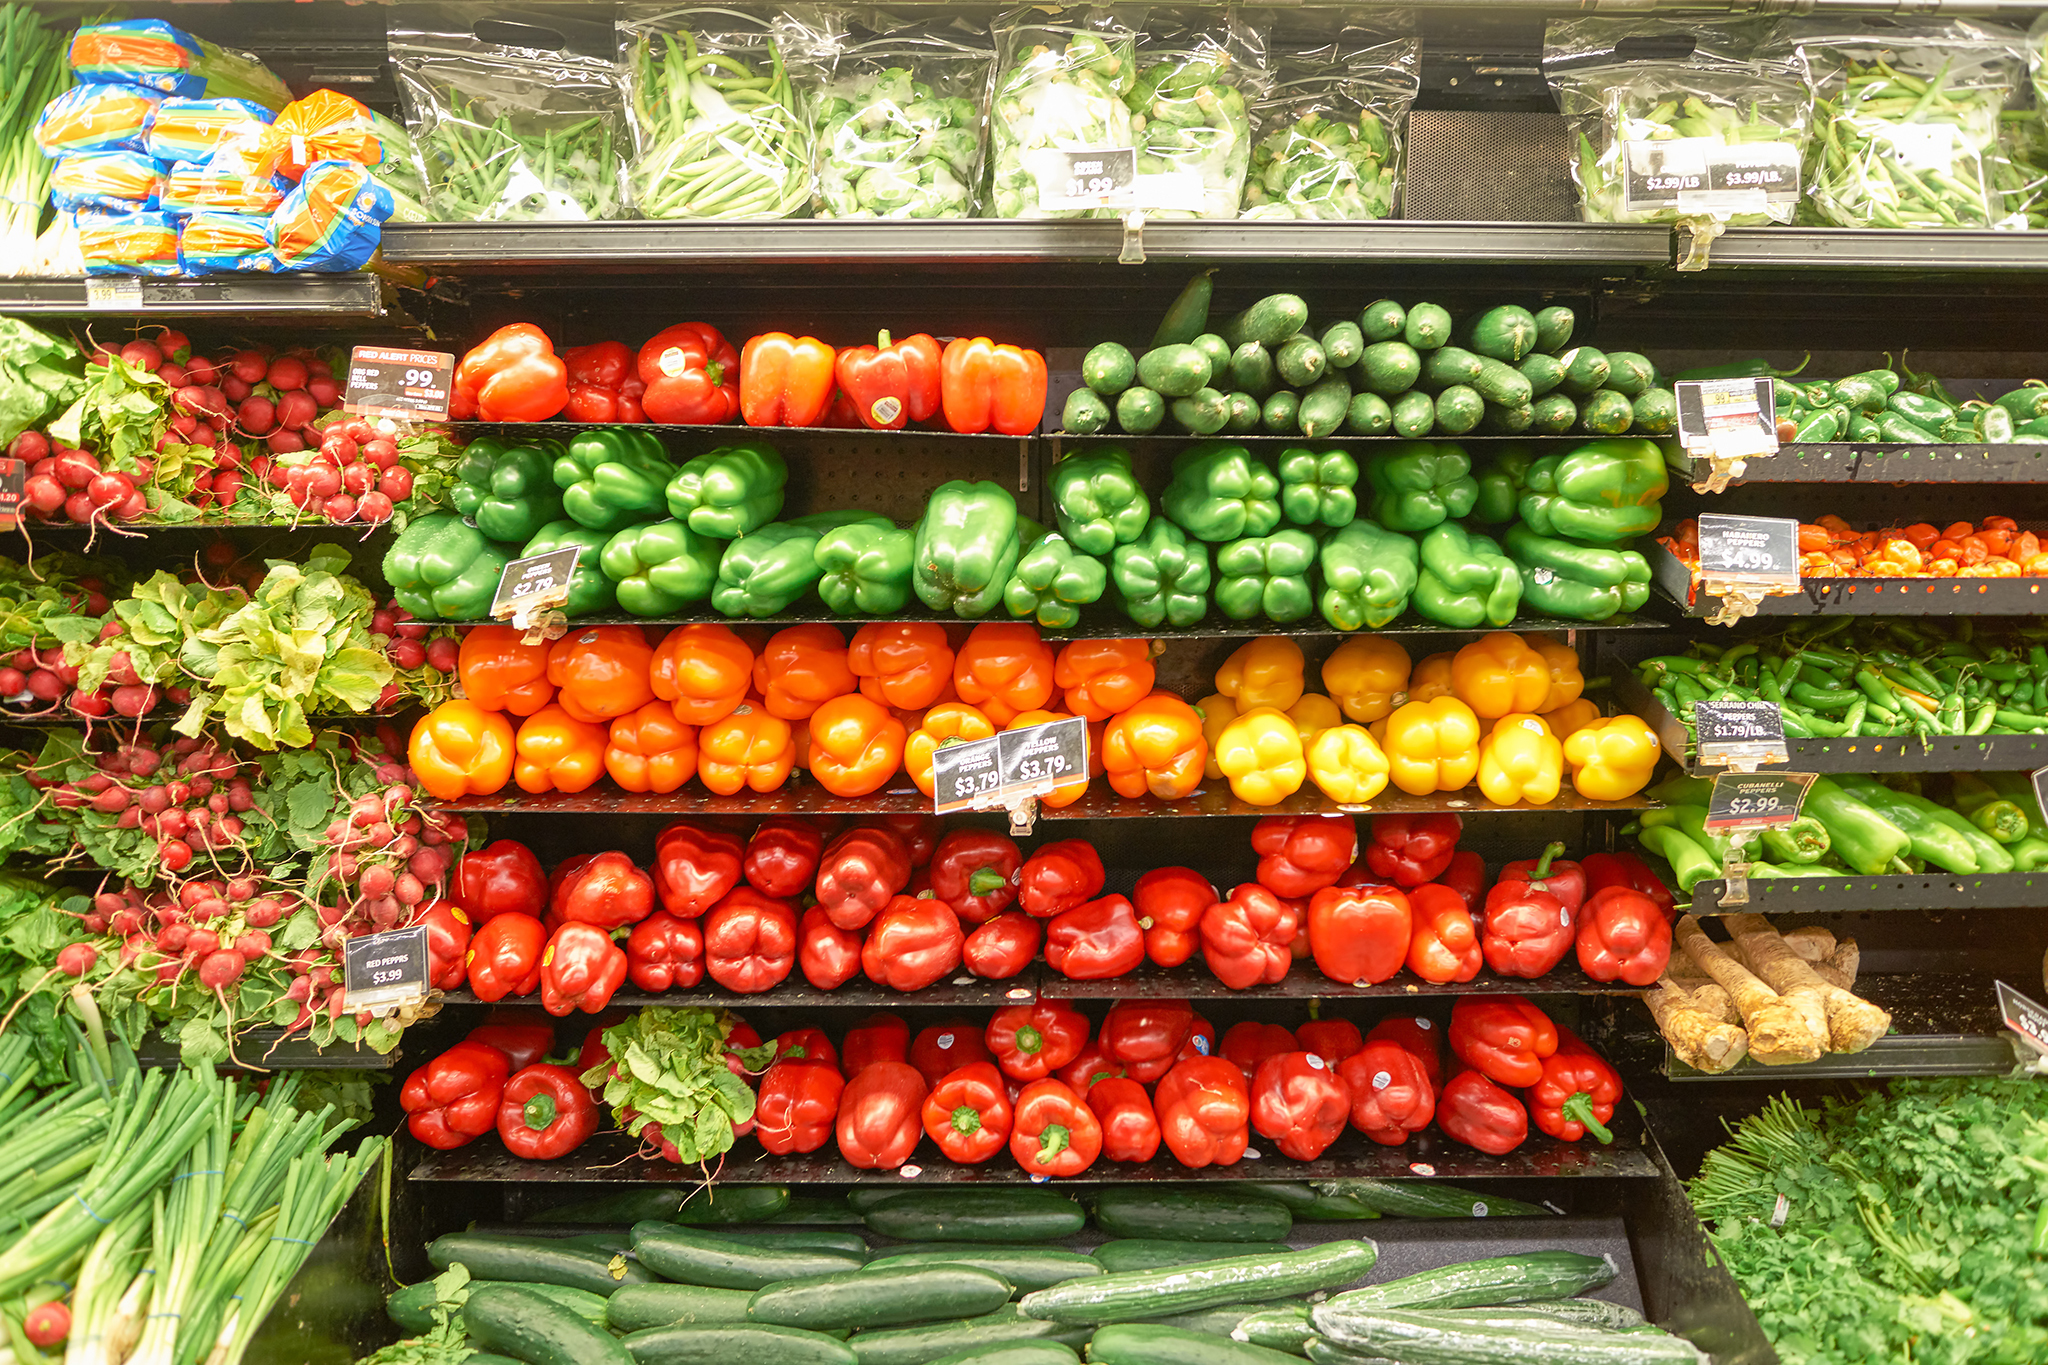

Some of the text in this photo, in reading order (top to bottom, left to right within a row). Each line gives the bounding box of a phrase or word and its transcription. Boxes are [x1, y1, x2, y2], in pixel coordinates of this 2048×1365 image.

[1647, 176, 1700, 191] $2.99/LB
[1726, 171, 1782, 187] $3.99/LB.
[1066, 178, 1112, 197] $1.99
[359, 351, 438, 364] RED ALERT PRICES
[351, 382, 378, 390] PEPPERS
[398, 370, 433, 388] .99
[1723, 531, 1770, 541] HABANERO
[1727, 539, 1766, 548] PEPPERS
[1722, 549, 1773, 570] $4.99
[512, 577, 554, 598] $2.79
[1711, 701, 1746, 710] SERRANO
[1024, 744, 1060, 757] PEPPERS
[1025, 737, 1057, 750] YELLOW
[960, 760, 992, 773] PEPPERS
[1020, 755, 1065, 780] $3.79
[955, 771, 998, 797] $3.79
[1729, 797, 1779, 815] $2.99
[367, 954, 409, 969] RED PEPPRS
[373, 969, 402, 985] $3.99
